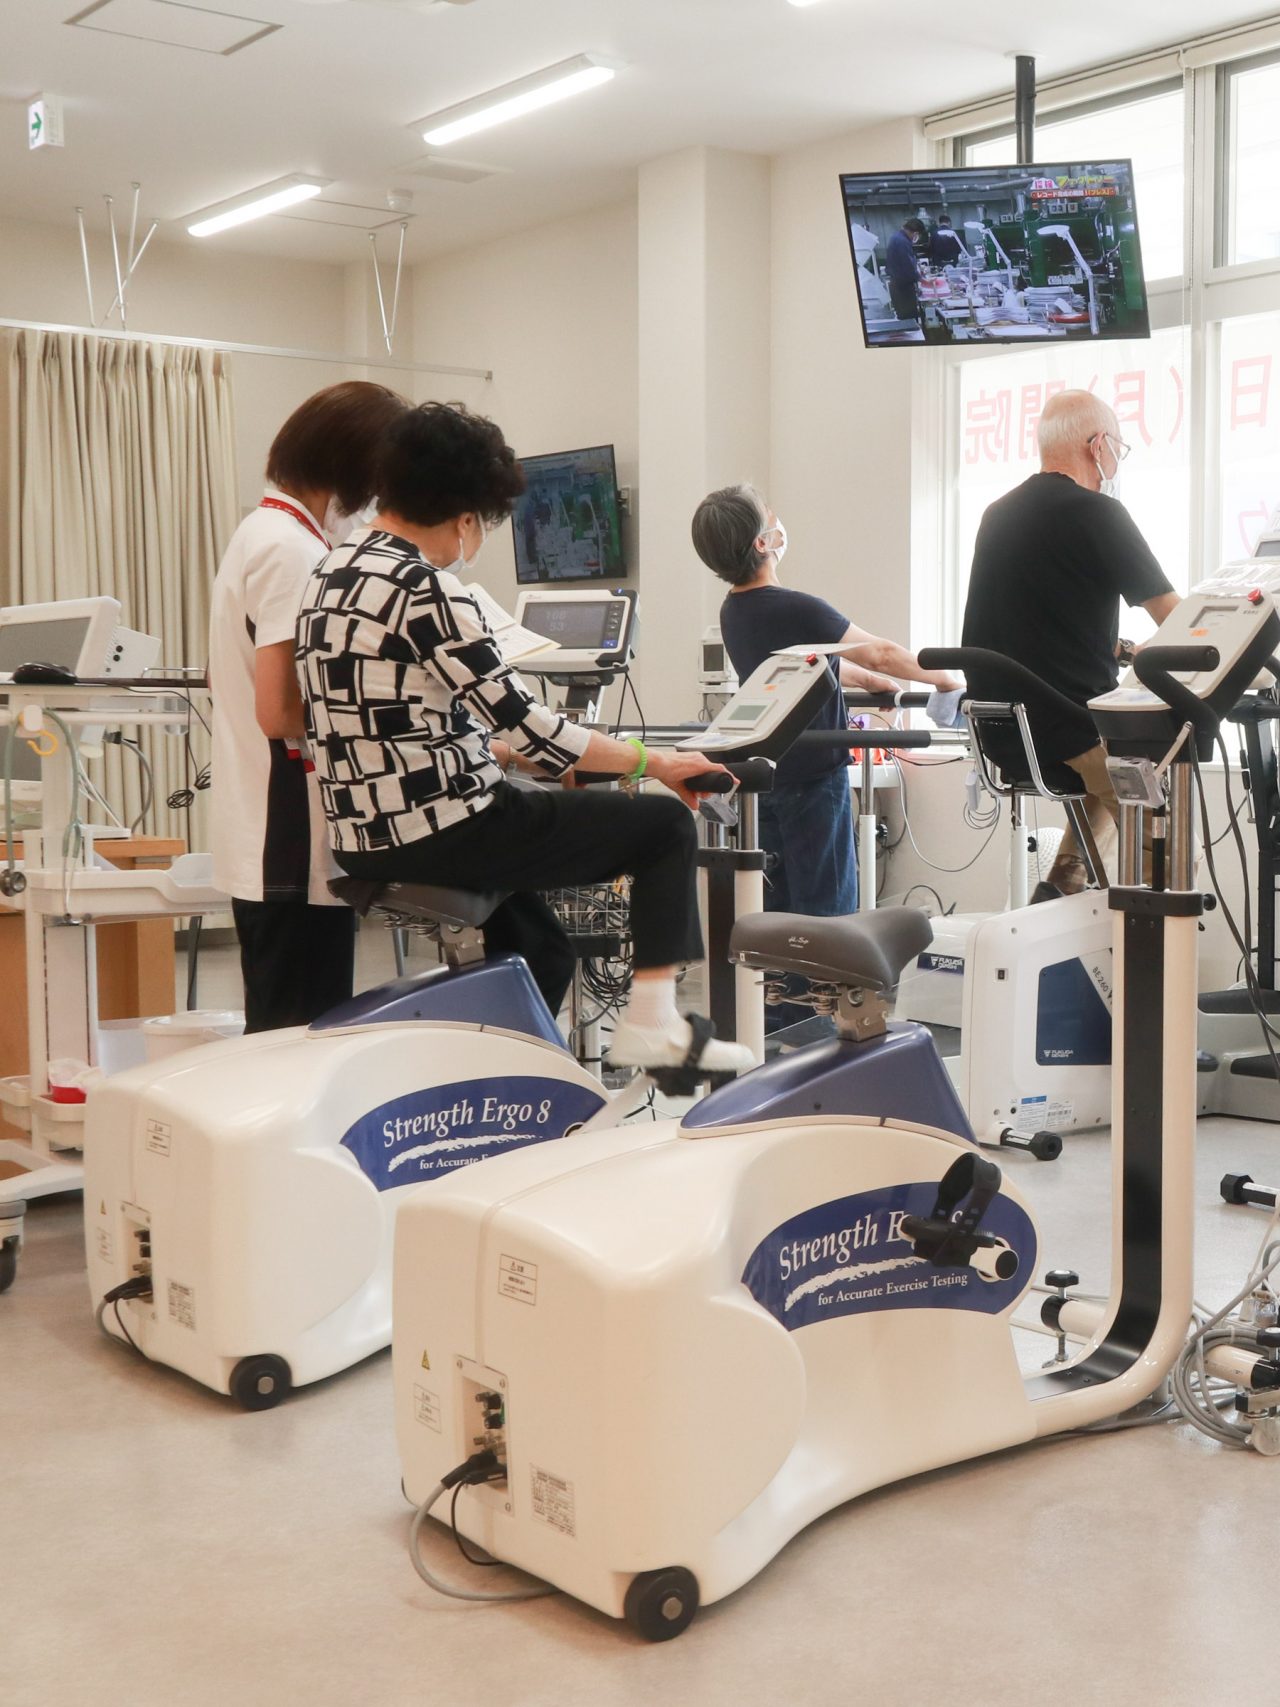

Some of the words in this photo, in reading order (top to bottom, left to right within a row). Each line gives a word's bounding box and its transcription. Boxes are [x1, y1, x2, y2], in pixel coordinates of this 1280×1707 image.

[383, 1100, 474, 1147] Strength
[480, 1097, 532, 1130] Ergo
[537, 1099, 551, 1124] 8
[419, 1159, 434, 1170] for
[436, 1156, 479, 1168] Accurate
[779, 1215, 878, 1281] Strength
[818, 1292, 833, 1306] for
[836, 1286, 883, 1303] Accurate
[886, 1278, 929, 1296] Exercise
[931, 1273, 968, 1288] Testing
